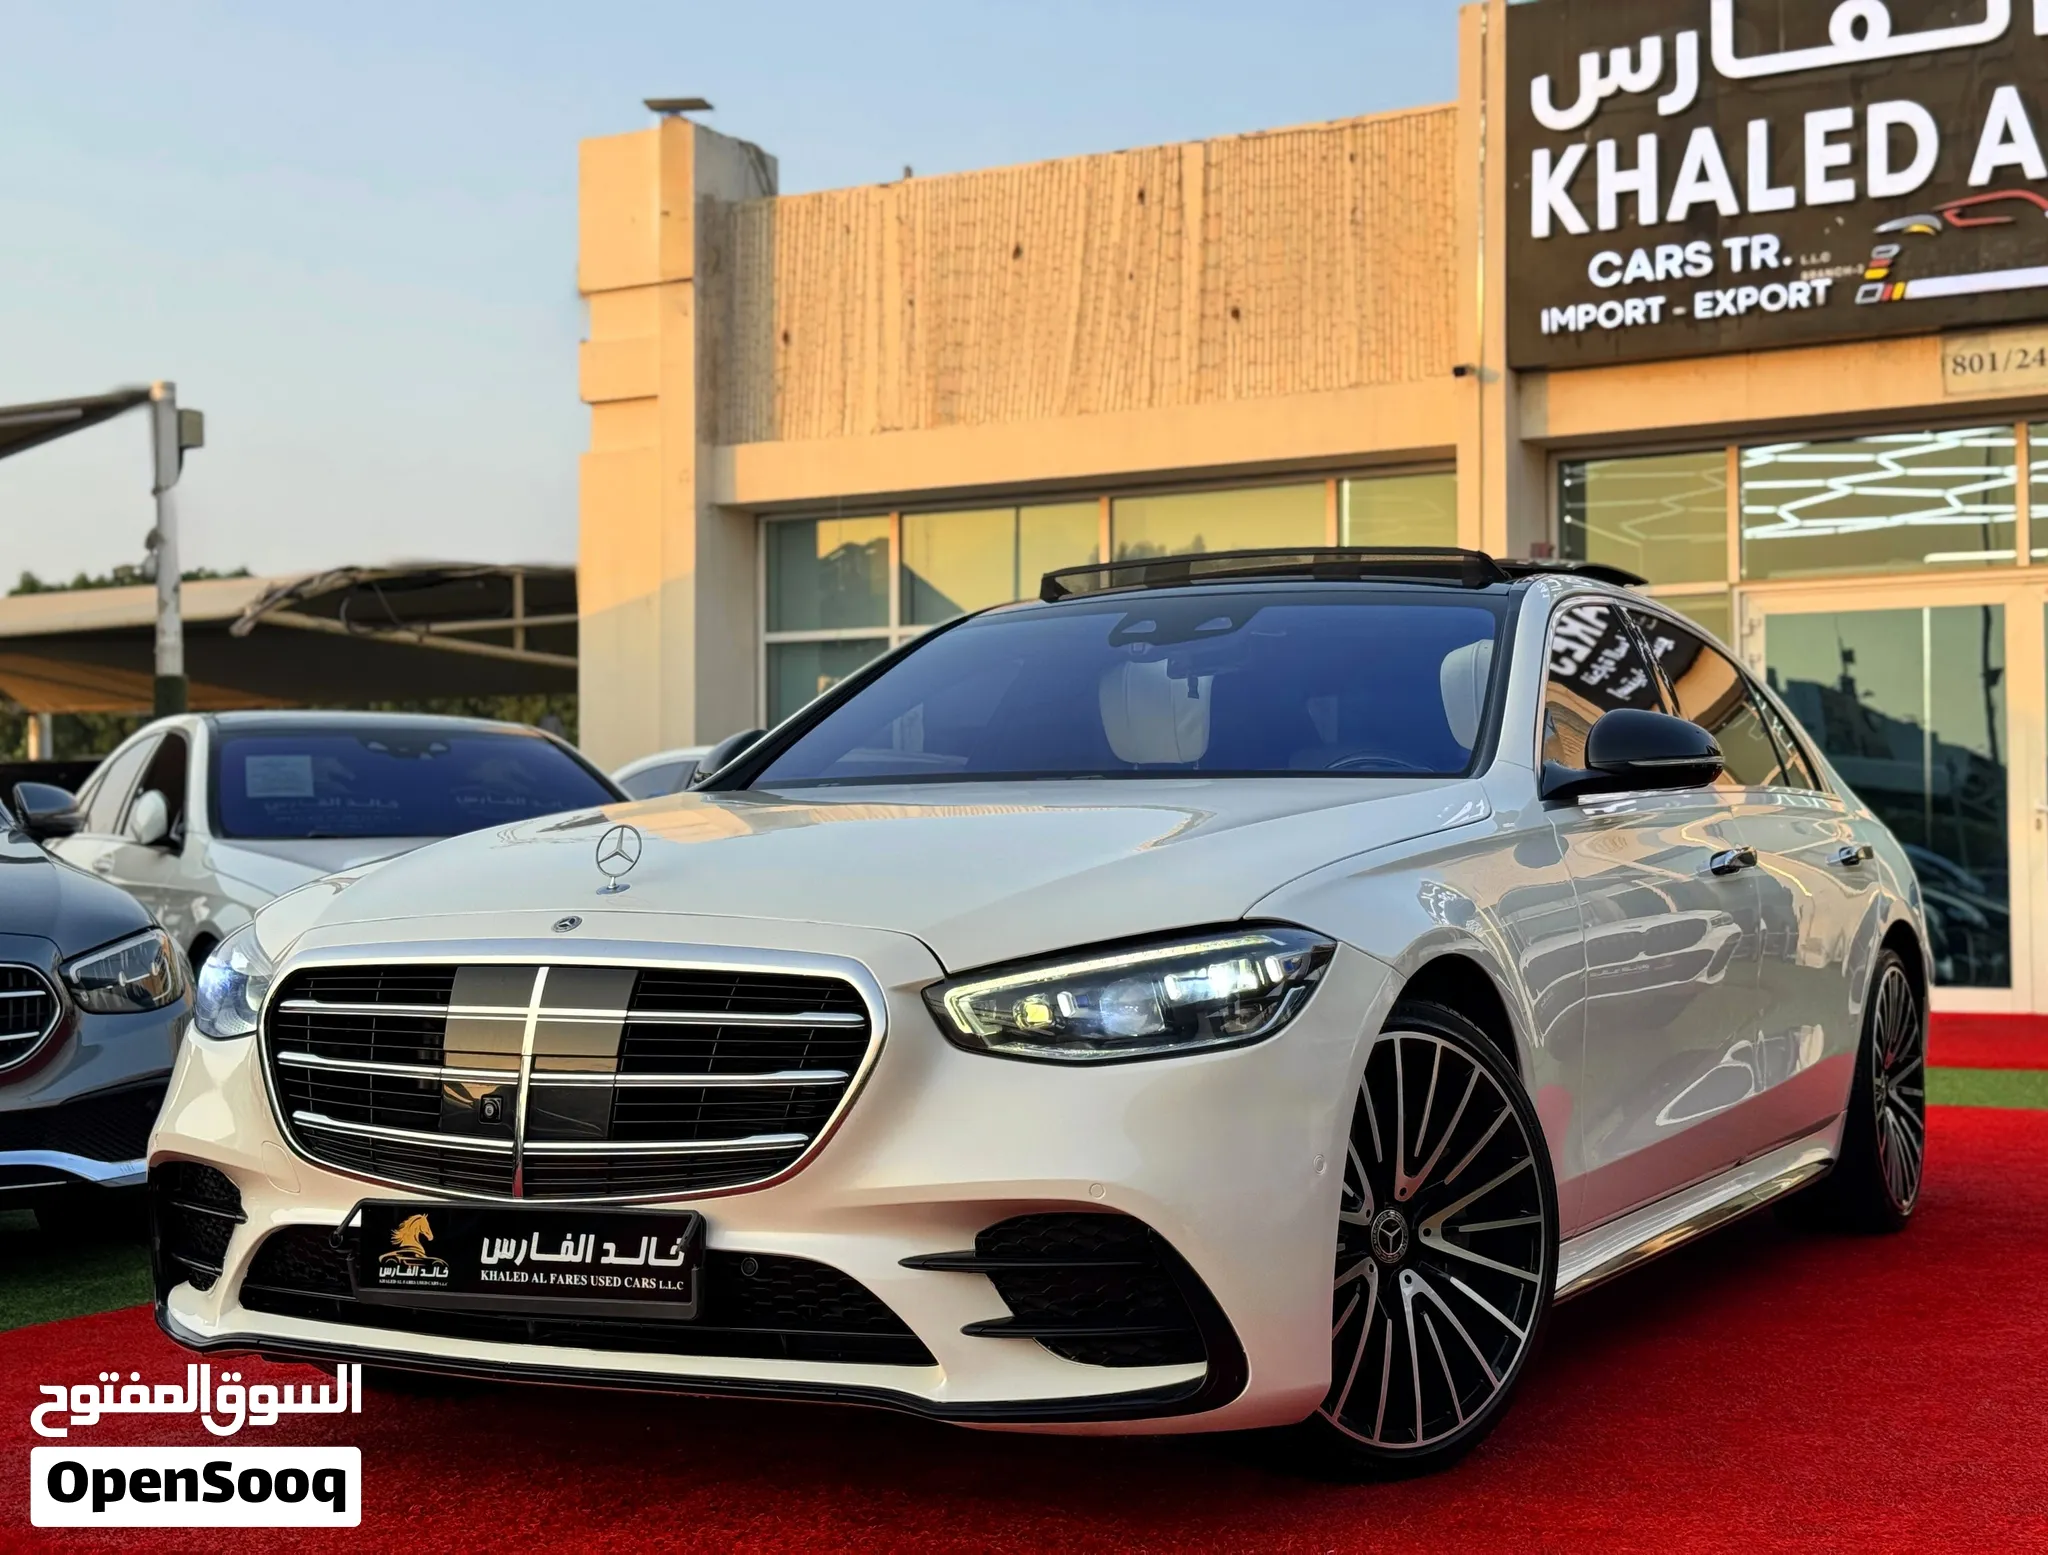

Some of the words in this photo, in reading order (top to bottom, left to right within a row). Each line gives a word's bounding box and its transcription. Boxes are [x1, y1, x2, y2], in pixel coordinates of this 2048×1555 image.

[1531, 99, 1940, 239] KHALED
[1967, 85, 2048, 187] A
[1587, 240, 1715, 289] CARS
[1722, 233, 1793, 273] TR.
[1540, 295, 1667, 335] IMPORT
[1693, 278, 1834, 320] EXPORT
[1952, 347, 2047, 377] 801/24
[481, 1232, 595, 1266] الفارس
[600, 1236, 685, 1267] خالد
[481, 1269, 529, 1283] KHALED
[531, 1272, 548, 1284] AL
[550, 1273, 588, 1286] FARES
[590, 1275, 622, 1288] USED
[624, 1276, 656, 1290] CARS
